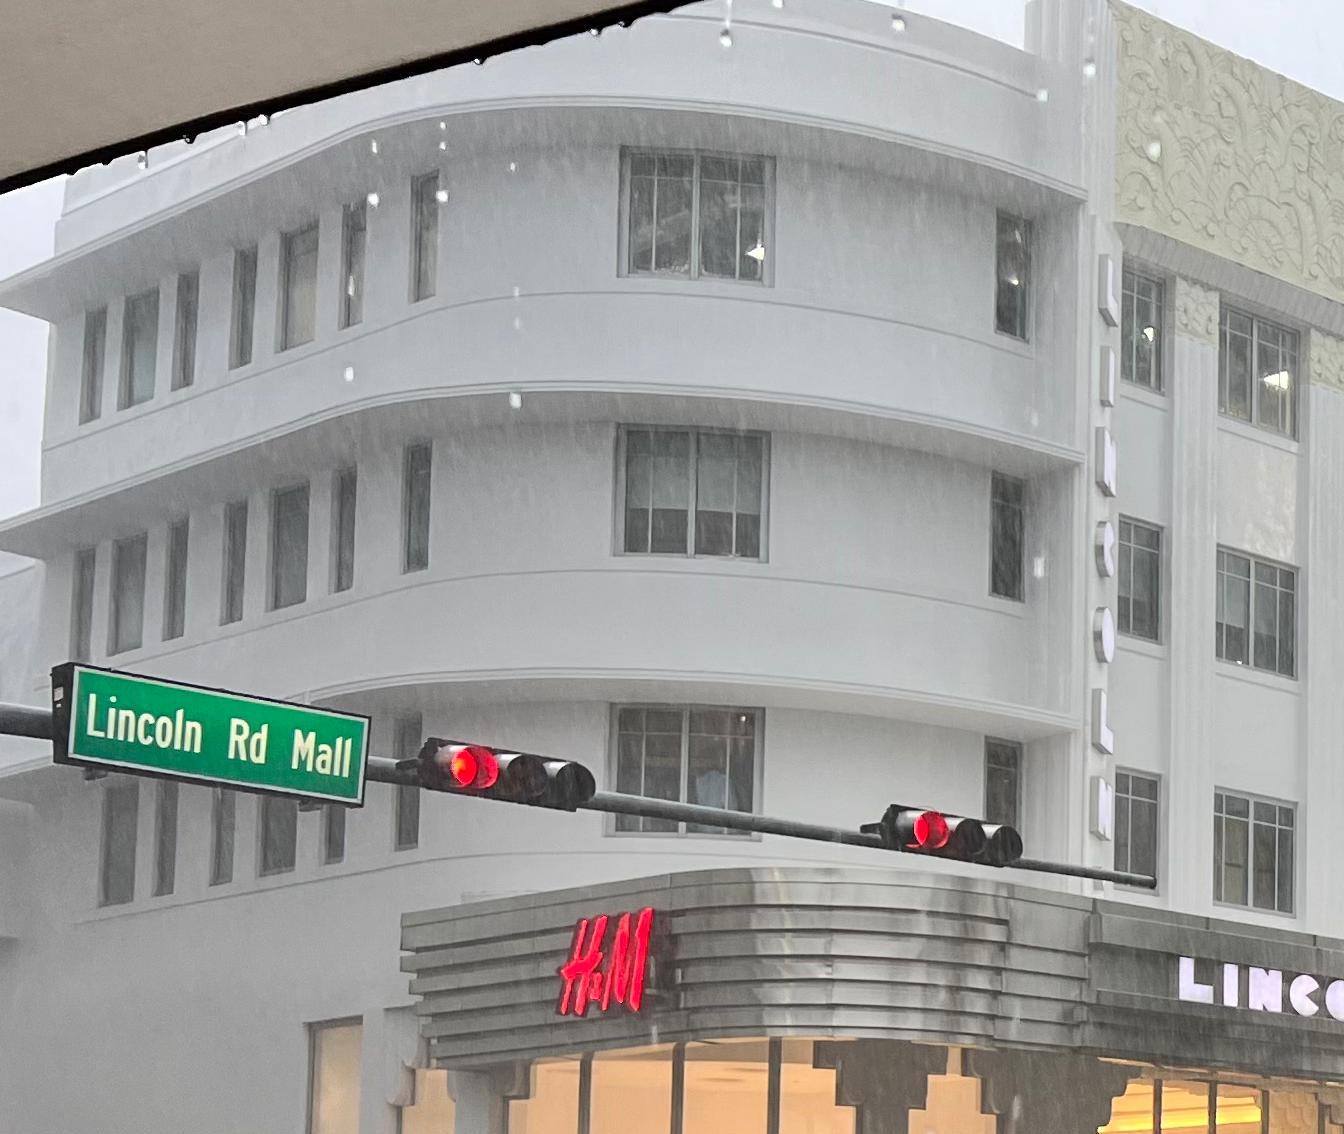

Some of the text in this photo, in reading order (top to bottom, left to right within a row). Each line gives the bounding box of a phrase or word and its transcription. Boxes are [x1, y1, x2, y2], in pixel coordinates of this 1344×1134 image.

[87, 693, 353, 779] Lincoln Rd Mall
[560, 907, 654, 1015] H&M
